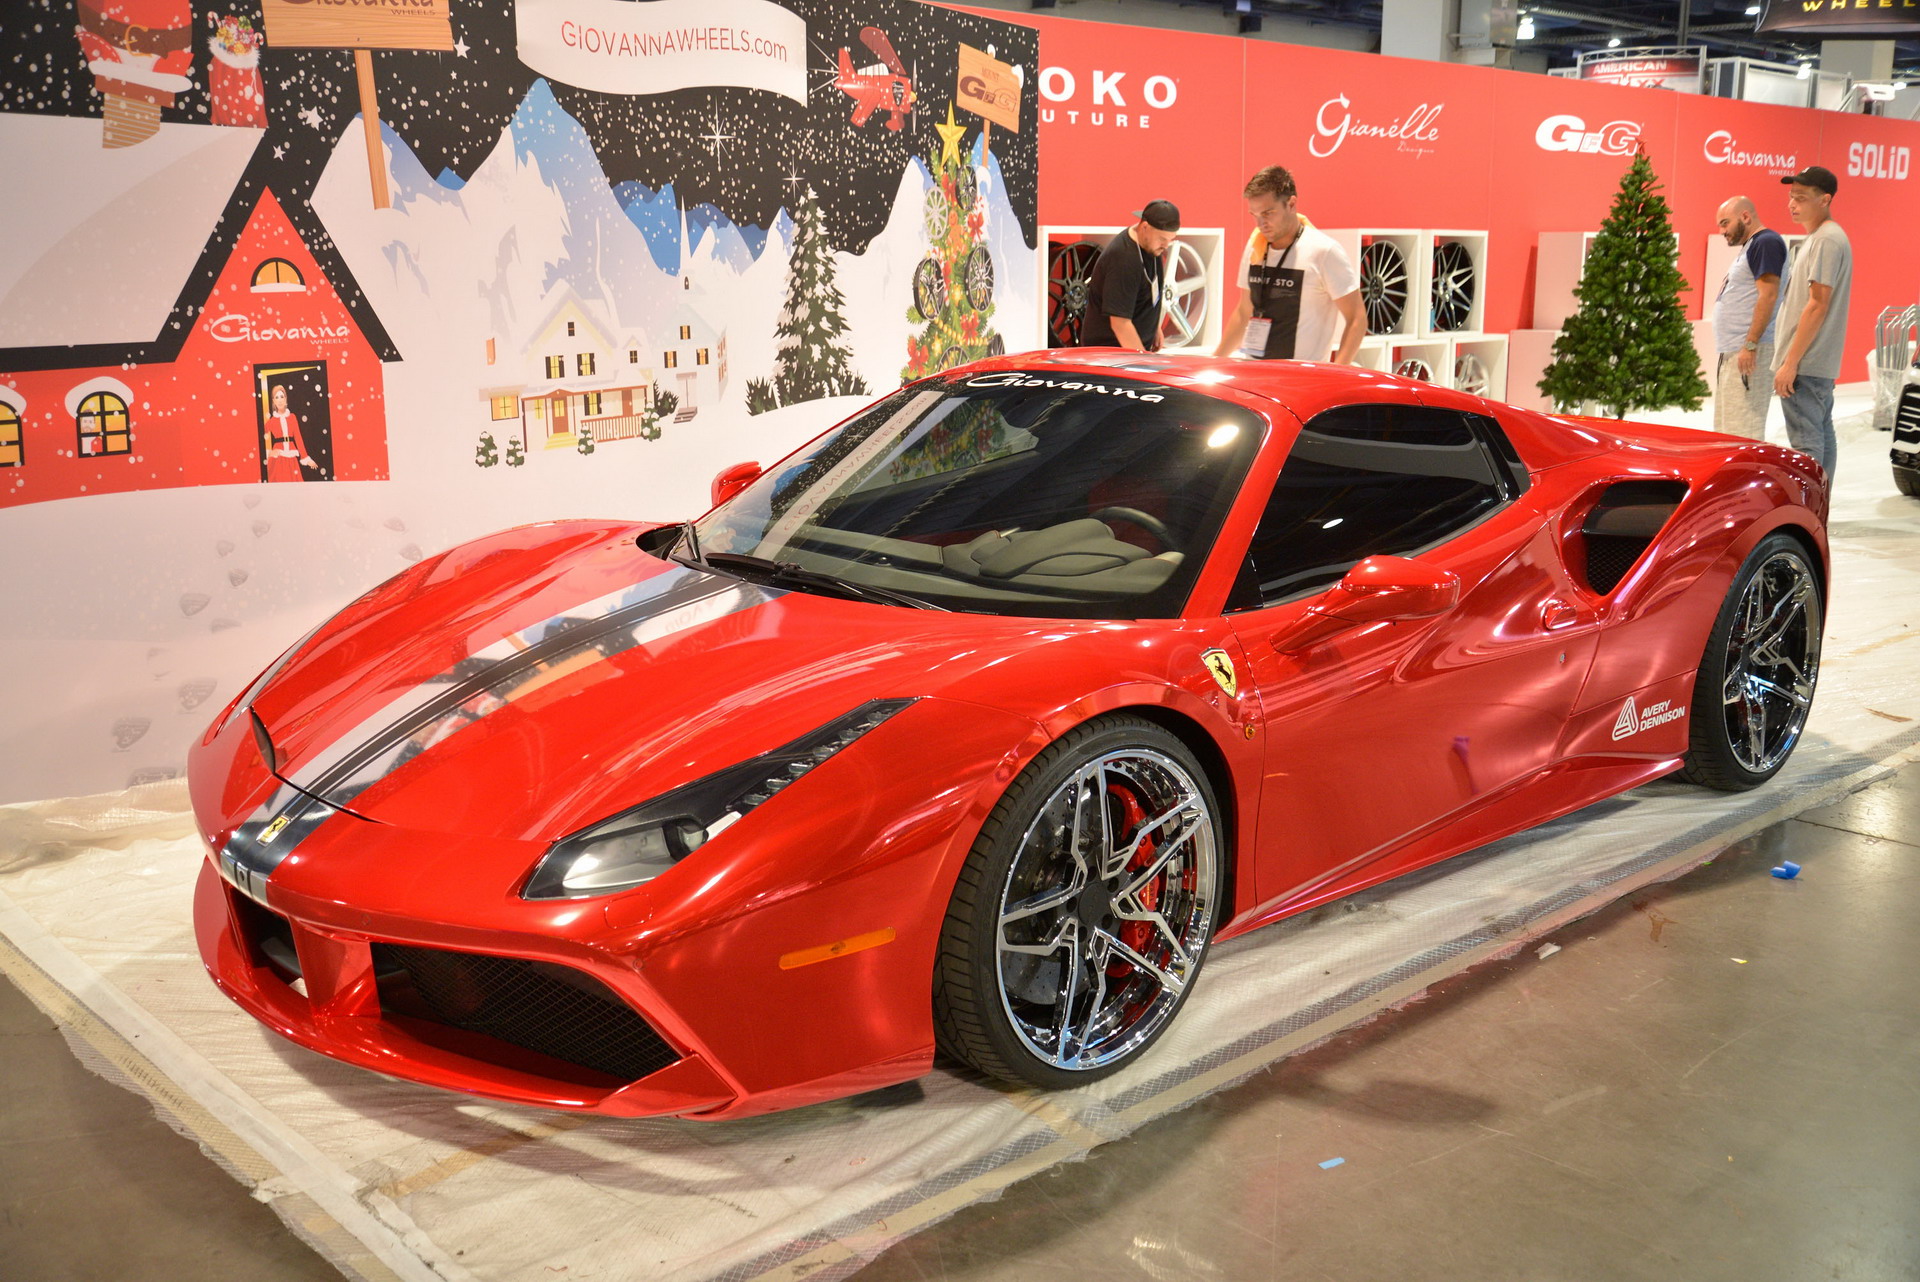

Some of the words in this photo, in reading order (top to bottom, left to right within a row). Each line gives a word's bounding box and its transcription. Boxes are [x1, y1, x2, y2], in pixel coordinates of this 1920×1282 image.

[561, 21, 788, 62] GIOVANNAWHEELS.com
[1593, 60, 1668, 74] AMERICAN
[1042, 109, 1150, 129] UTURE
[1704, 130, 1796, 169] Giovanna
[1768, 169, 1795, 177] WHEELS
[211, 314, 349, 343] Giovanna
[966, 373, 1165, 403] Giovanna
[1640, 706, 1686, 732] DENNISON
[1641, 700, 1671, 720] AVERY
